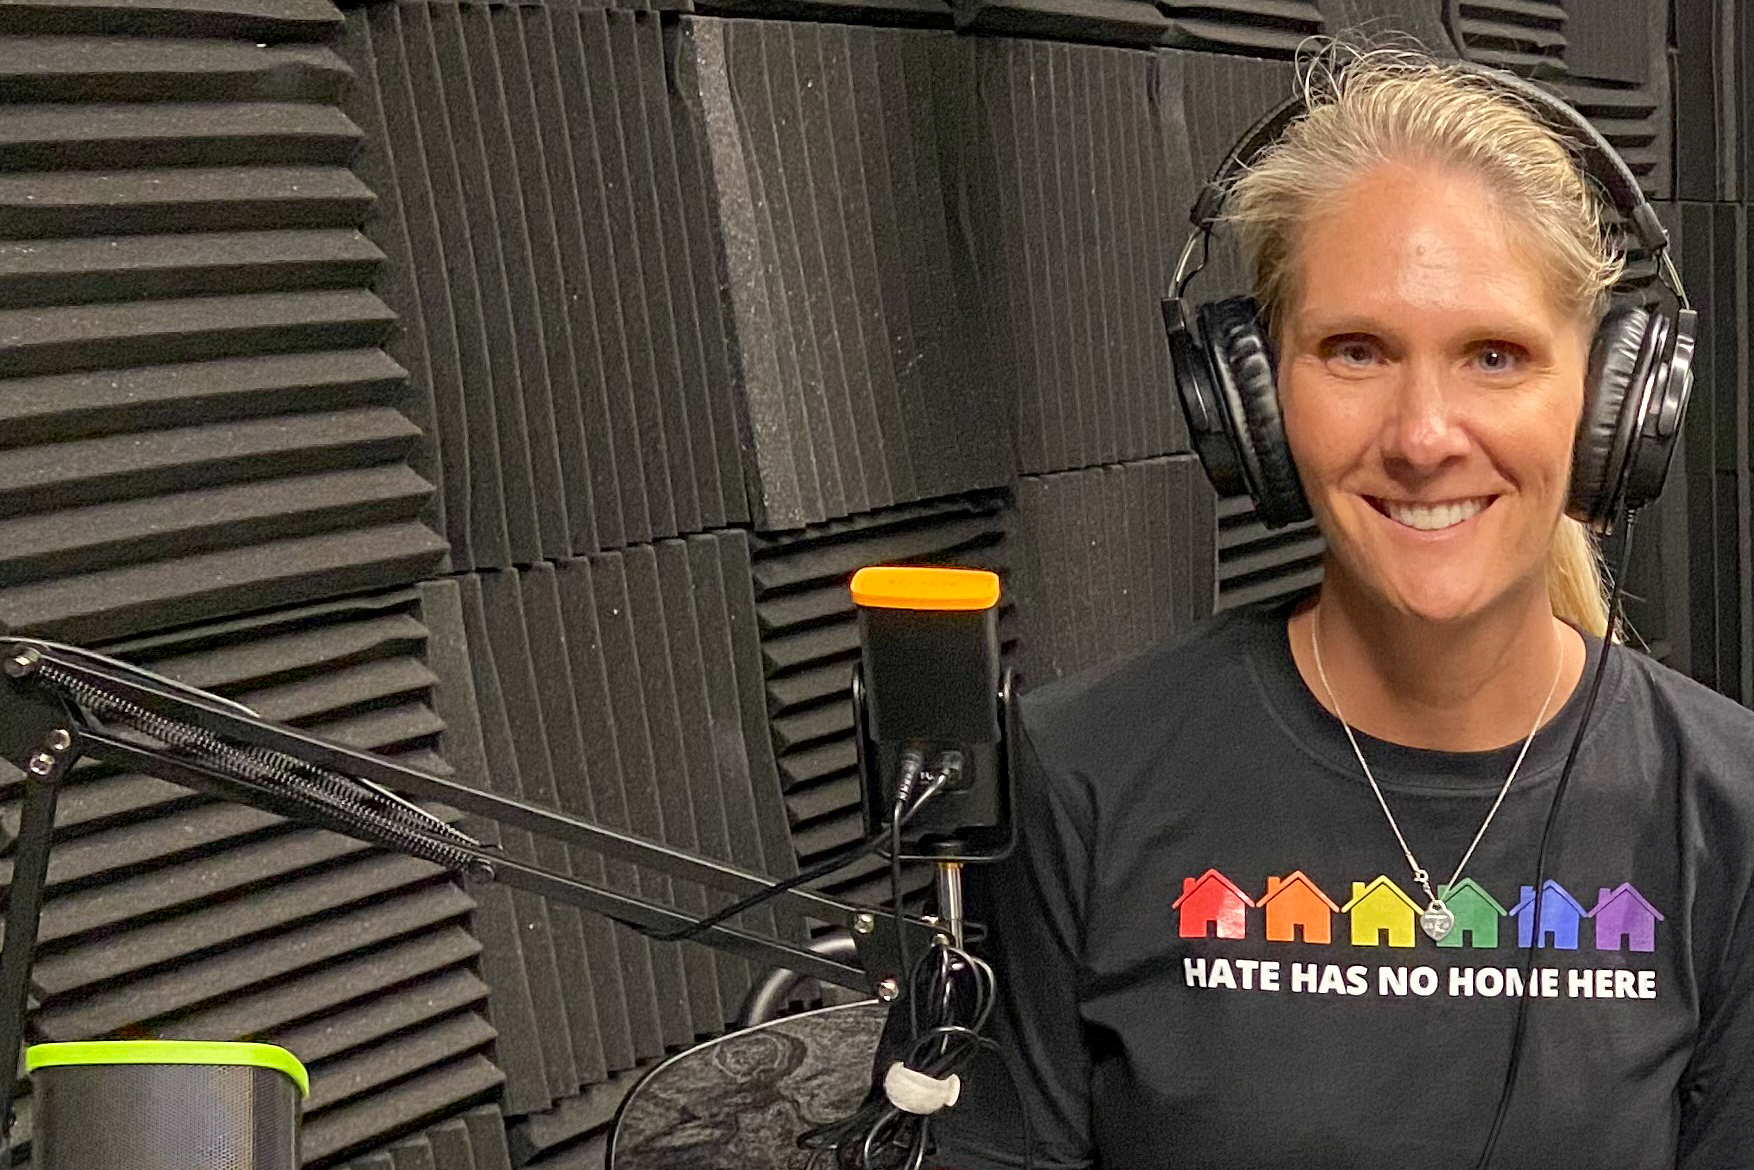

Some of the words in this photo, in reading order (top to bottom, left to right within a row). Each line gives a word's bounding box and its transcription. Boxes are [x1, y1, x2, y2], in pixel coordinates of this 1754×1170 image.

[1183, 957, 1280, 991] HATE
[1291, 962, 1369, 996] HAS
[1378, 966, 1439, 996] NO
[1449, 967, 1559, 997] HOME
[1568, 969, 1657, 998] HERE
